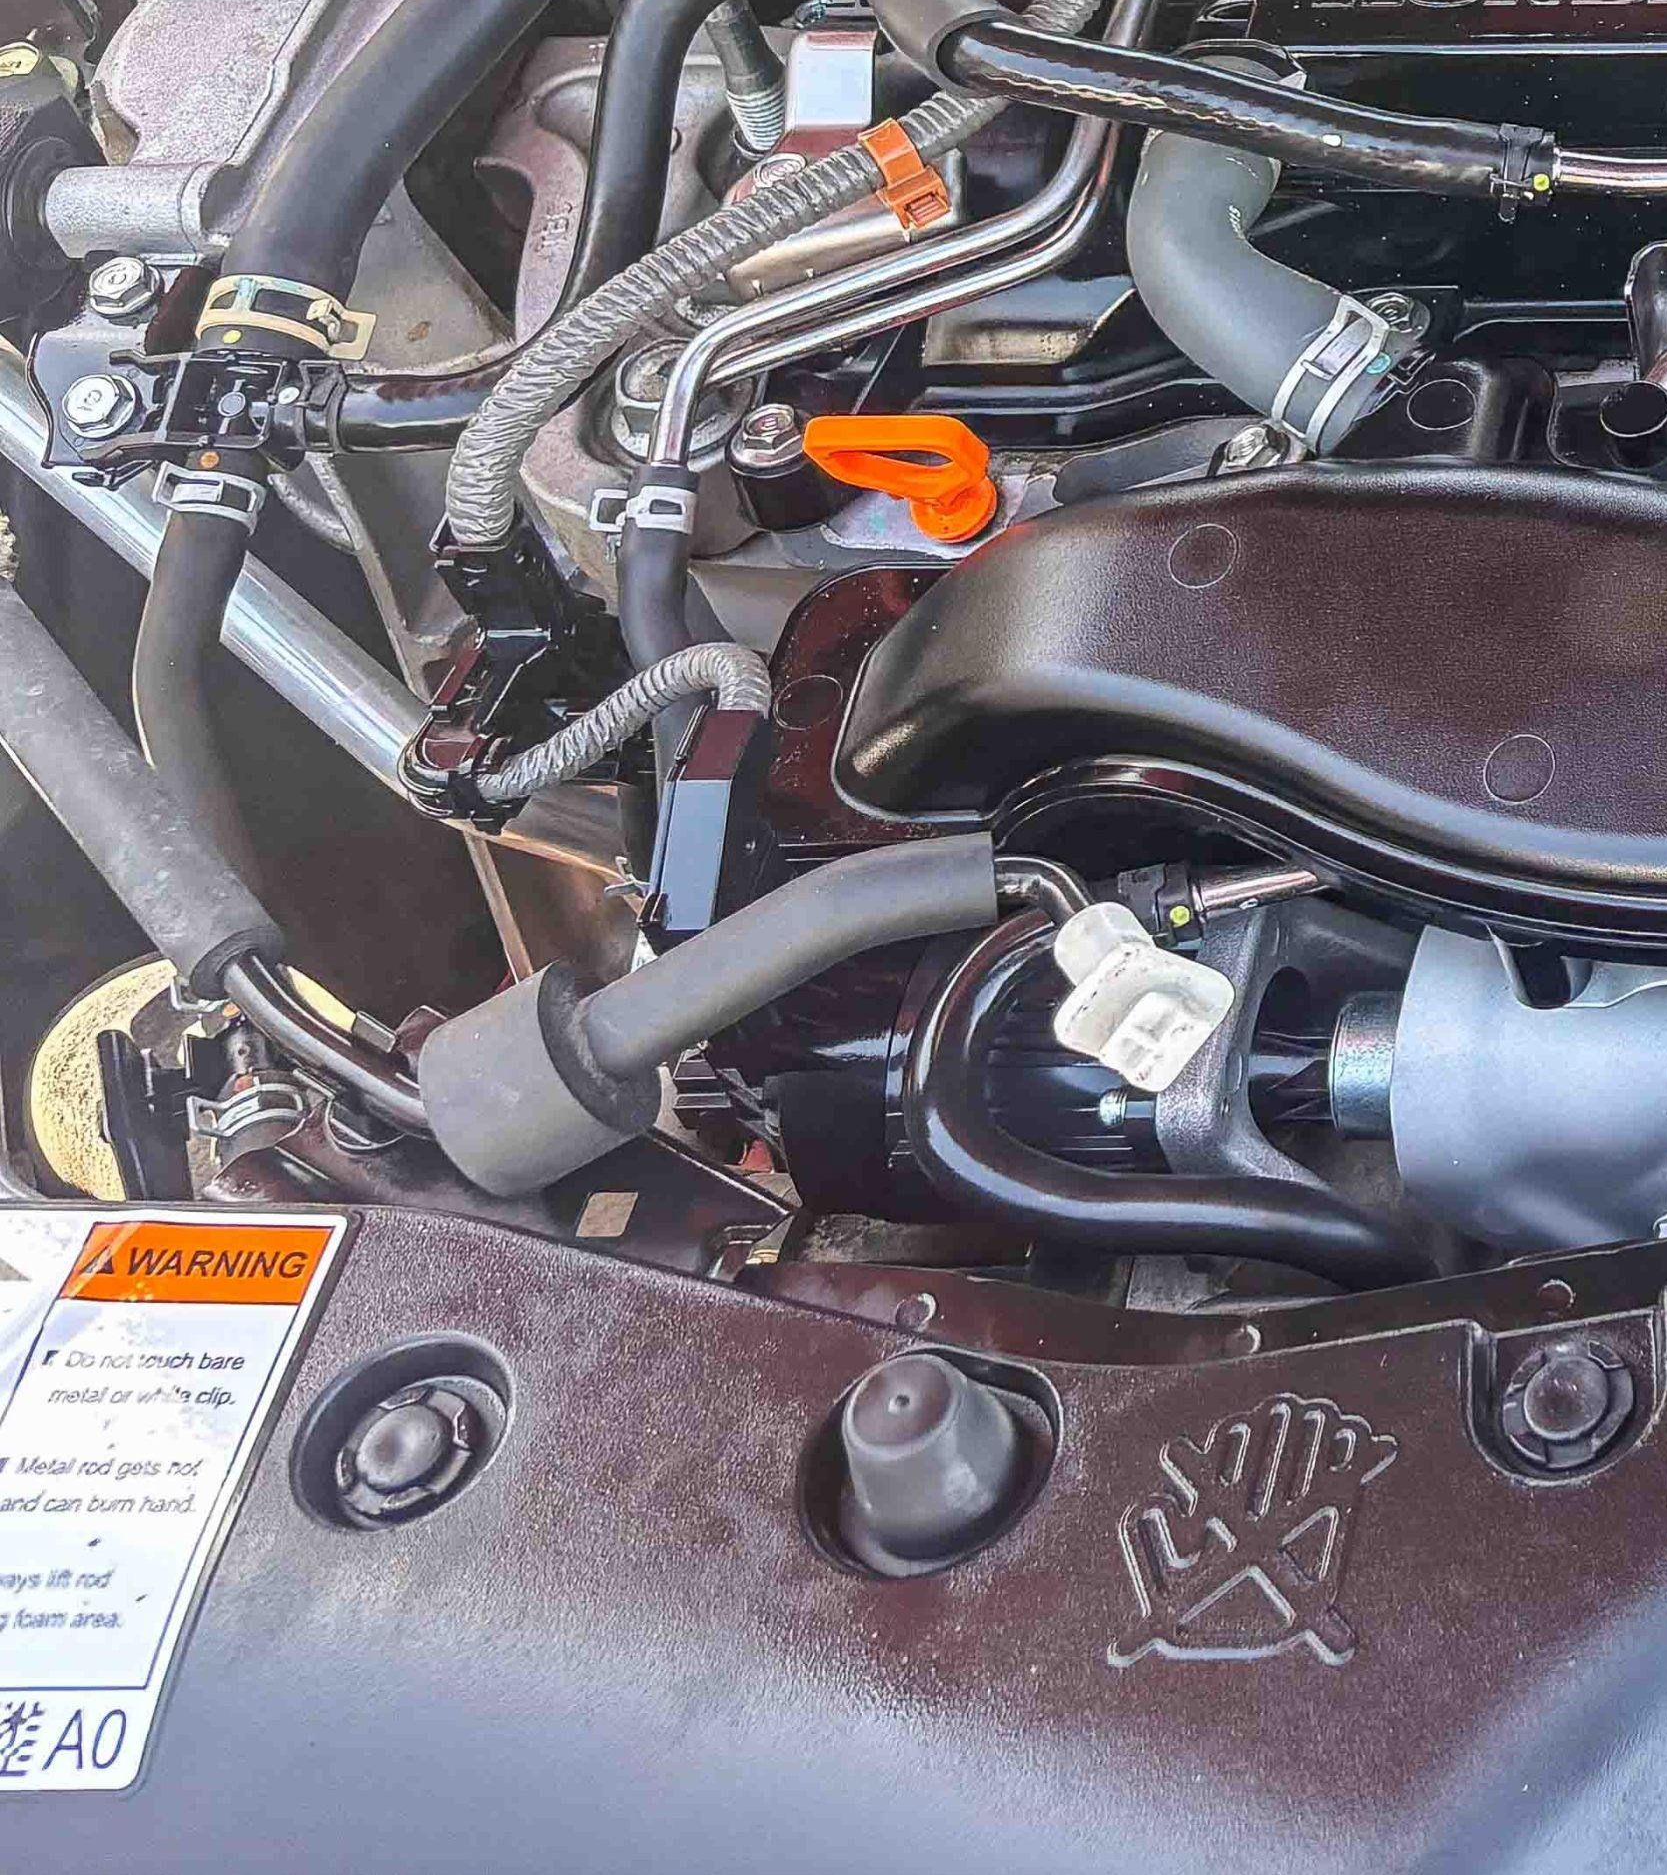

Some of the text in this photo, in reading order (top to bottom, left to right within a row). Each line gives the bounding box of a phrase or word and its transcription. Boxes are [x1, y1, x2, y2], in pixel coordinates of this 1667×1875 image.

[127, 1248, 310, 1281] WARNING
[65, 1351, 96, 1368] Do
[198, 1351, 246, 1372] bare
[48, 1387, 108, 1405] metal
[110, 1390, 130, 1404] or
[15, 1457, 76, 1476] Metal
[78, 1458, 113, 1477] rod
[43, 1495, 82, 1513] can
[75, 1567, 115, 1590] rod
